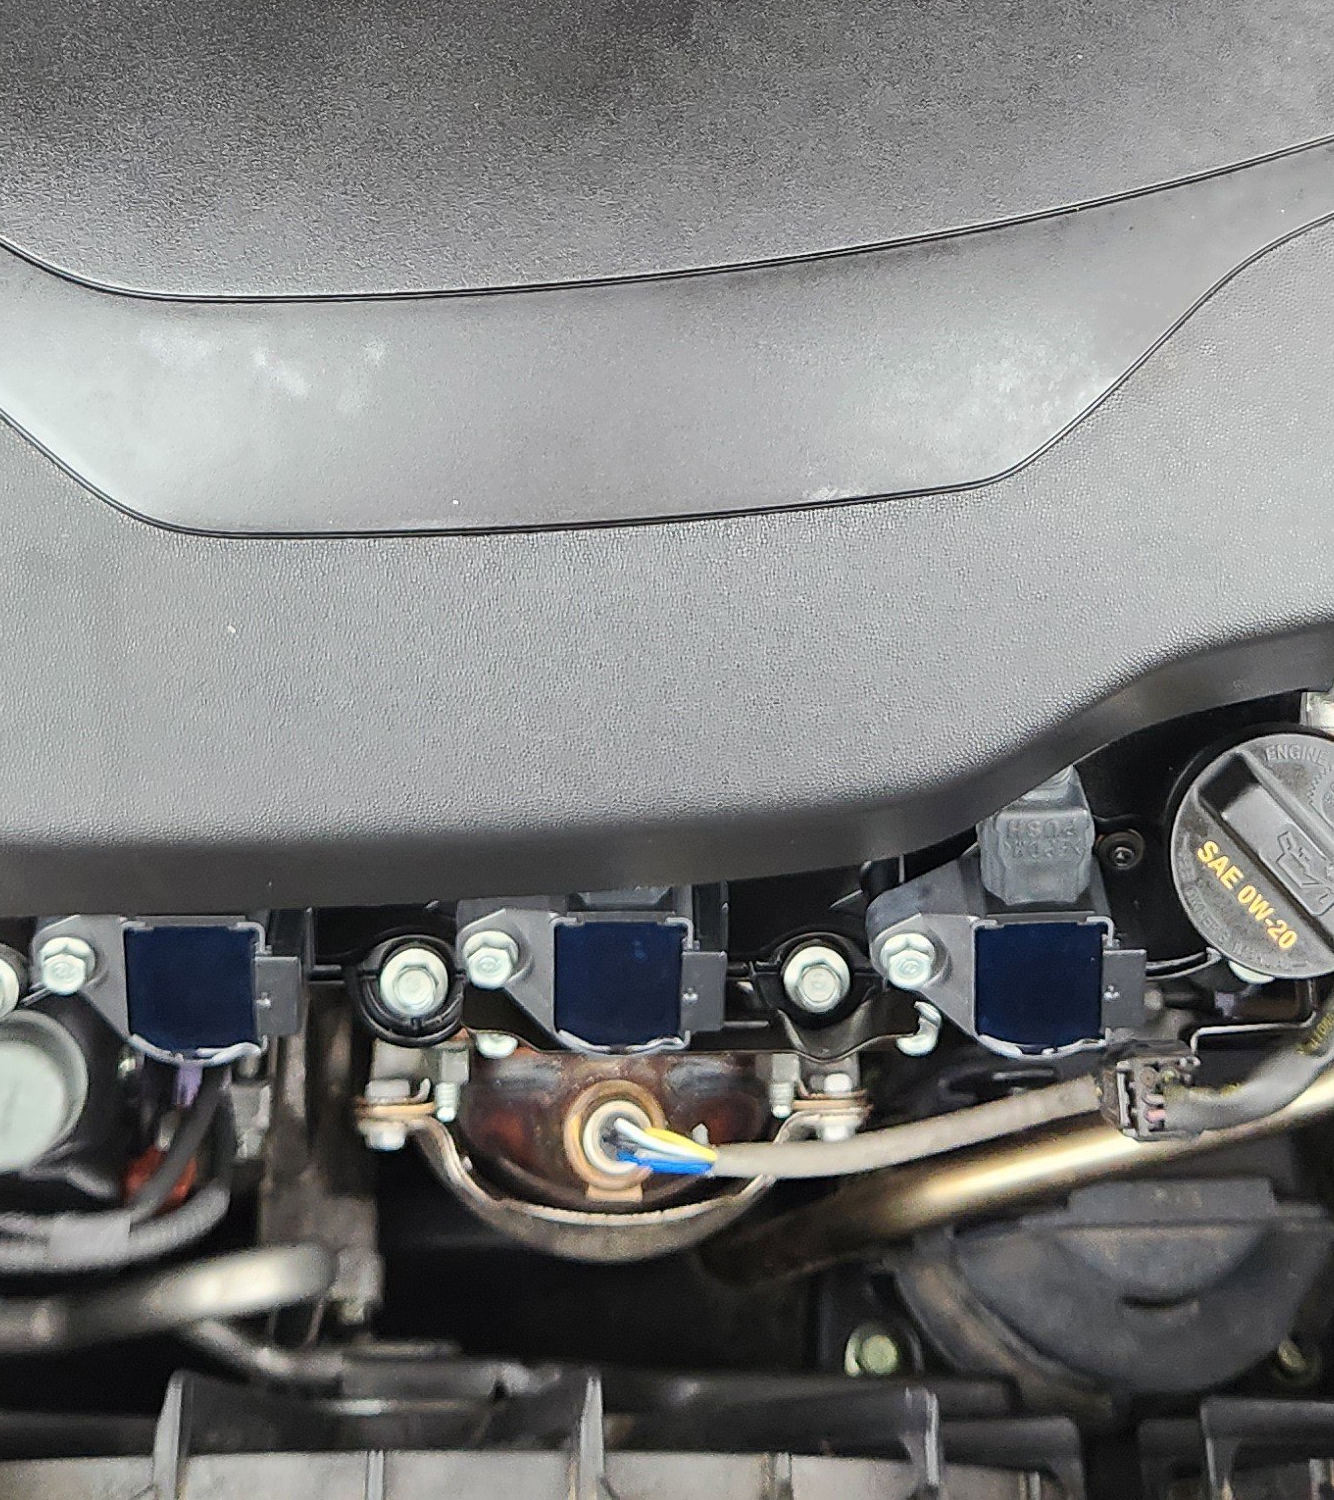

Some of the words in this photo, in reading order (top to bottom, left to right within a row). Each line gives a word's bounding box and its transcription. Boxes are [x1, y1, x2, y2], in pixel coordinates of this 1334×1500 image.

[1265, 744, 1331, 767] ENGINE
[1197, 840, 1244, 890] SAE
[1238, 885, 1298, 950] 0W-20
